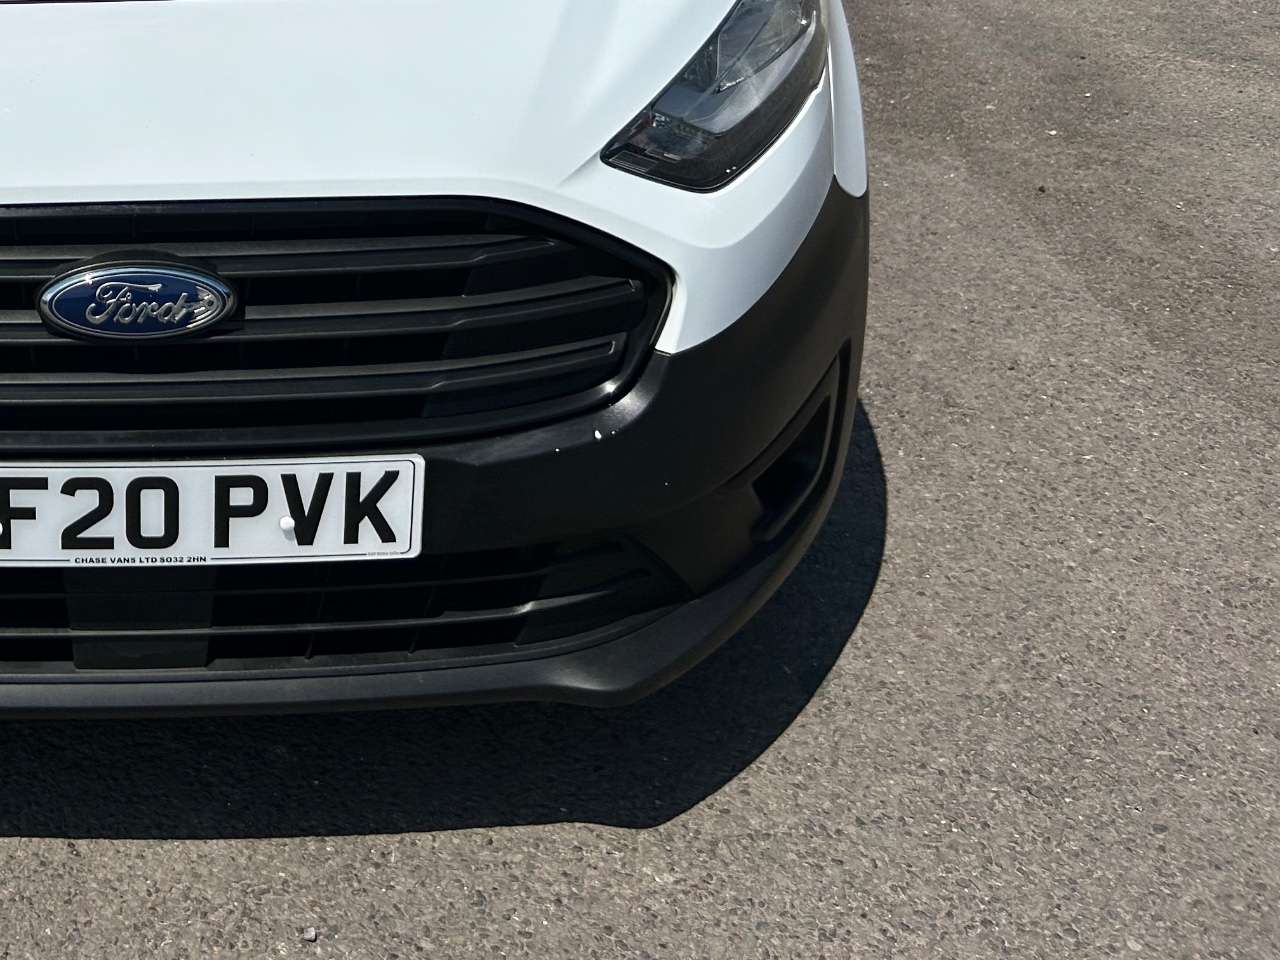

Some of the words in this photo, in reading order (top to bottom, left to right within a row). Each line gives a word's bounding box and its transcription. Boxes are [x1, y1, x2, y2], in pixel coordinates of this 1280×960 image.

[85, 281, 189, 325] Ford
[214, 470, 400, 548] PVK
[74, 556, 107, 564] CHASE
[109, 556, 136, 564] VANS
[139, 556, 158, 564] LTD
[187, 555, 207, 563] 2HN
